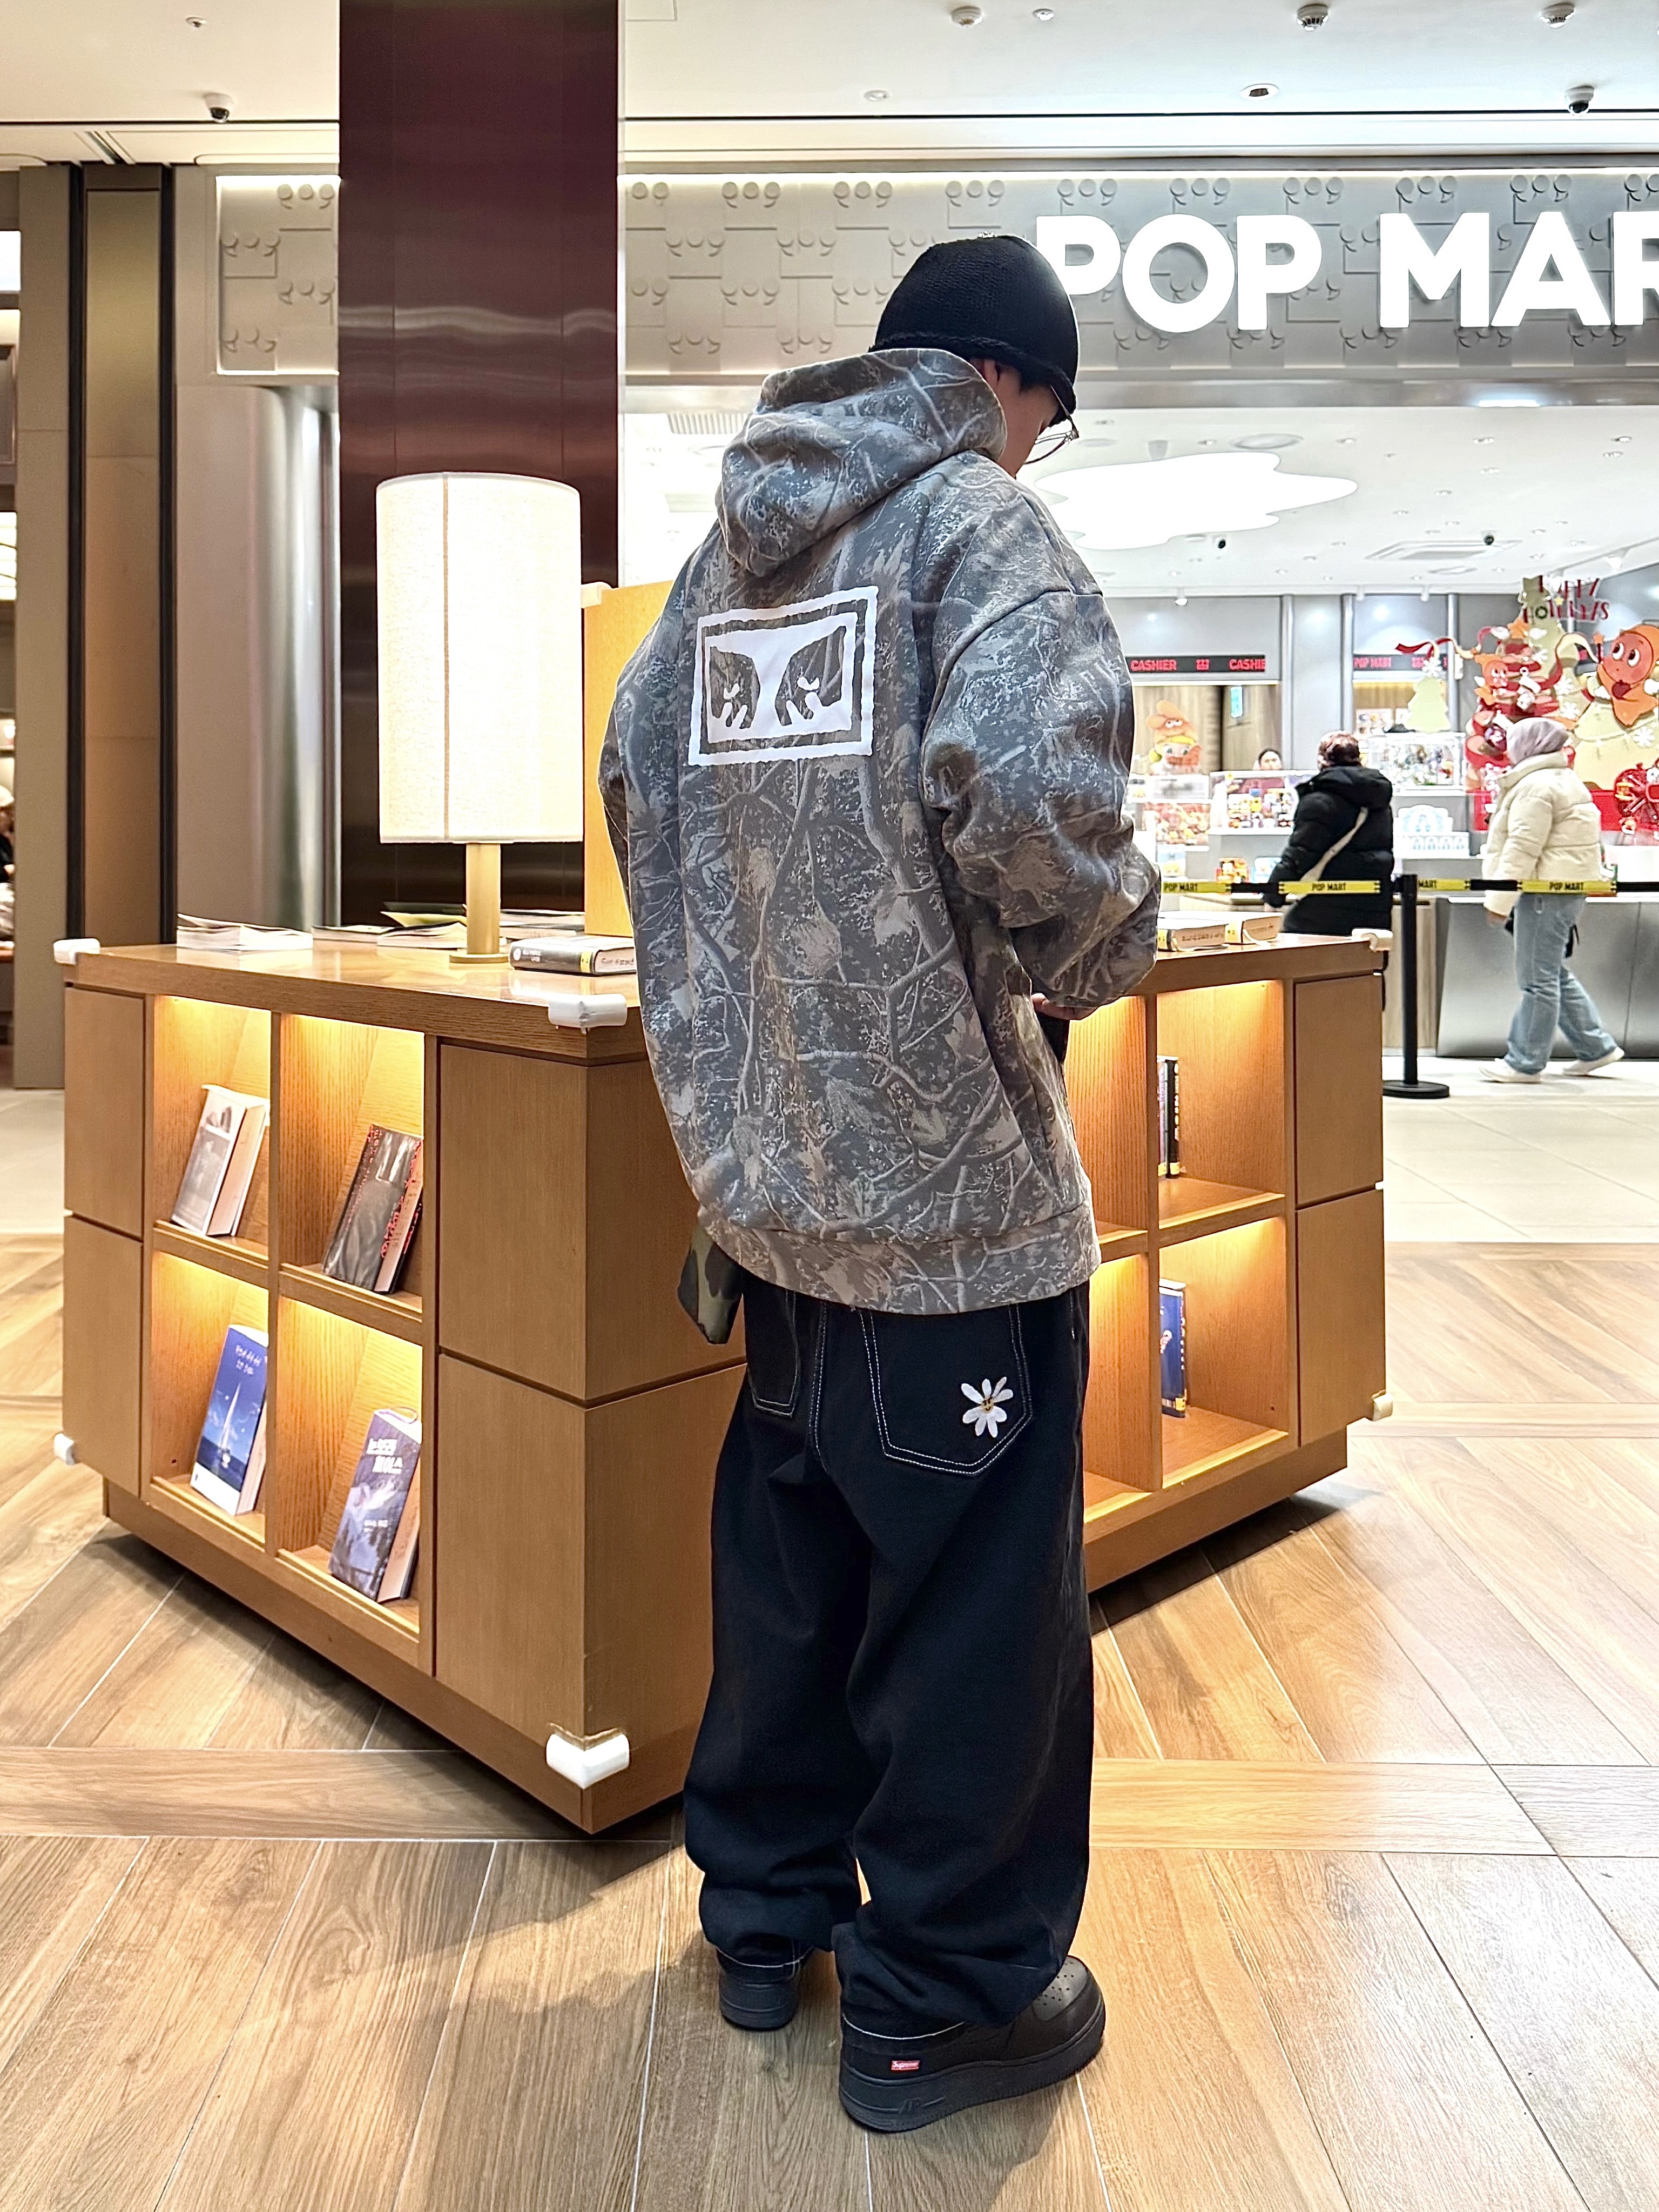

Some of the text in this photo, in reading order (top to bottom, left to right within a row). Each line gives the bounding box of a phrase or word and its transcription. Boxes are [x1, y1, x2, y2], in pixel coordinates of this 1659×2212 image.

[1036, 213, 1323, 333] POP
[1130, 658, 1177, 671] CASHIER
[1163, 882, 1198, 892] POP MART
[1311, 882, 1346, 891] POP MART
[1418, 879, 1438, 888] MART
[1549, 882, 1583, 890] POP MART
